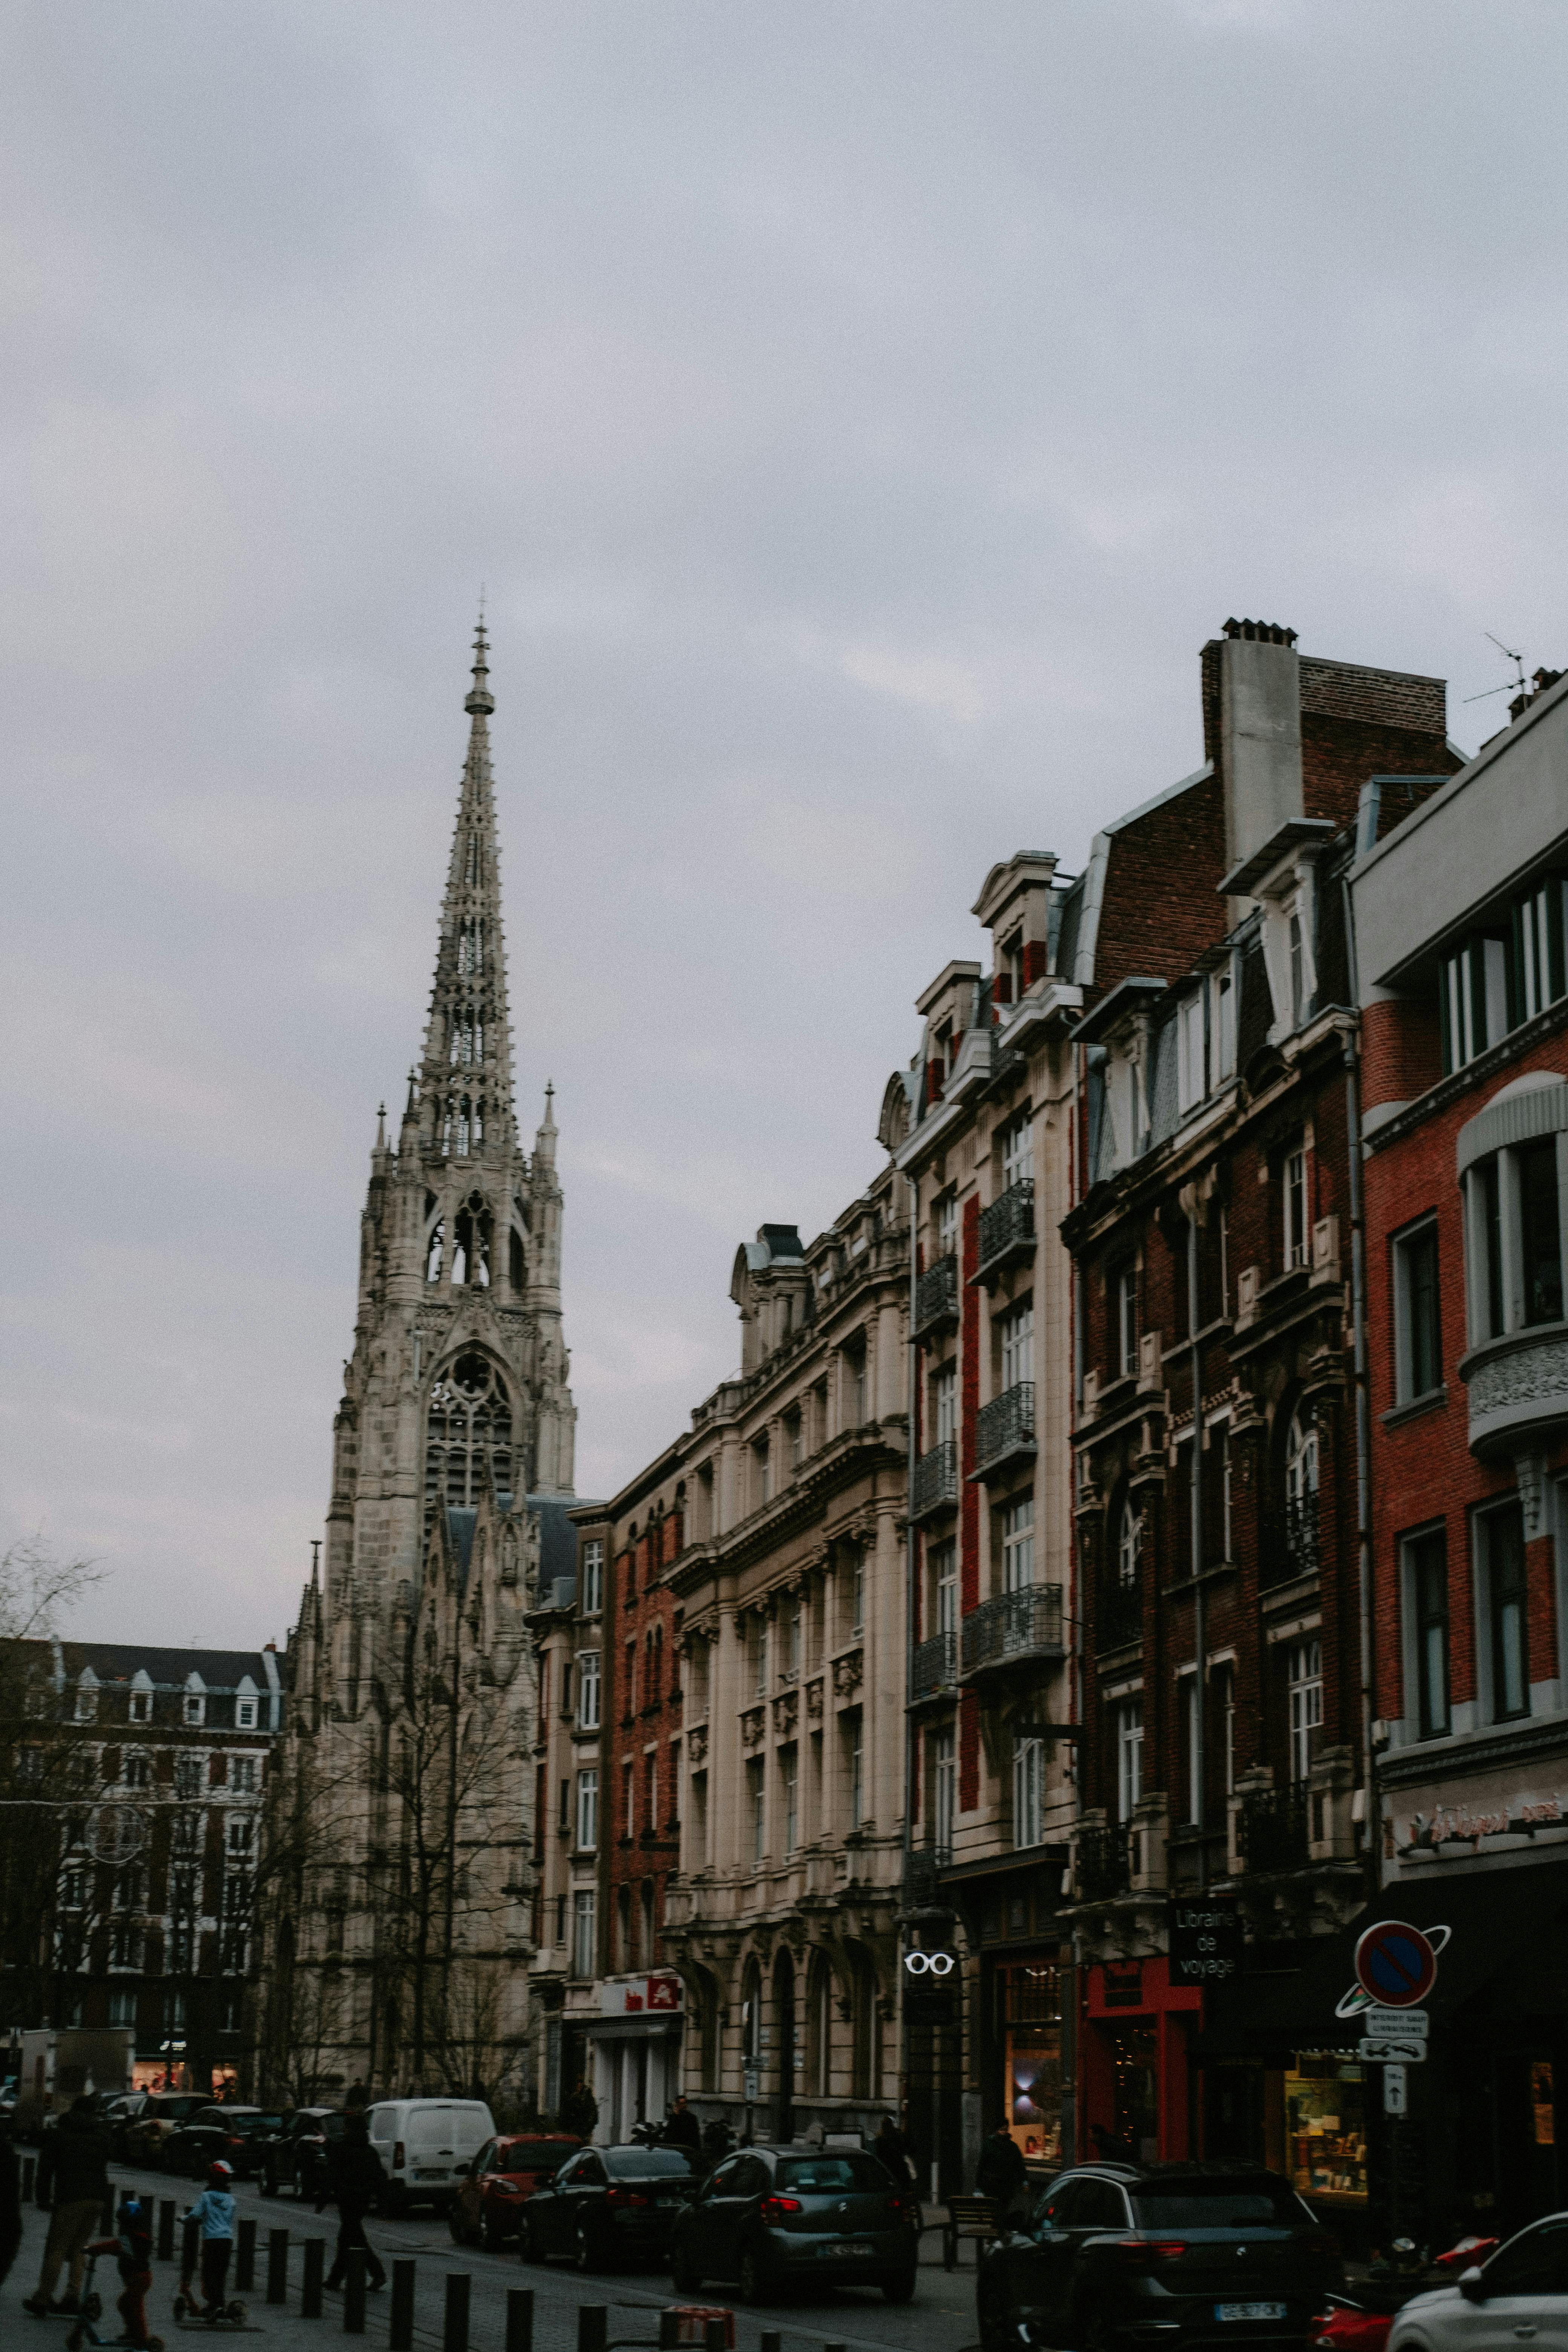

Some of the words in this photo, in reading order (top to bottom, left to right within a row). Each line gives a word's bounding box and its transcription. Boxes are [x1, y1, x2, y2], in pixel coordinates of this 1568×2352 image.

[1176, 1908, 1236, 1928] Librairie
[1196, 1933, 1217, 1951] de
[1180, 1959, 1236, 1978] voyage
